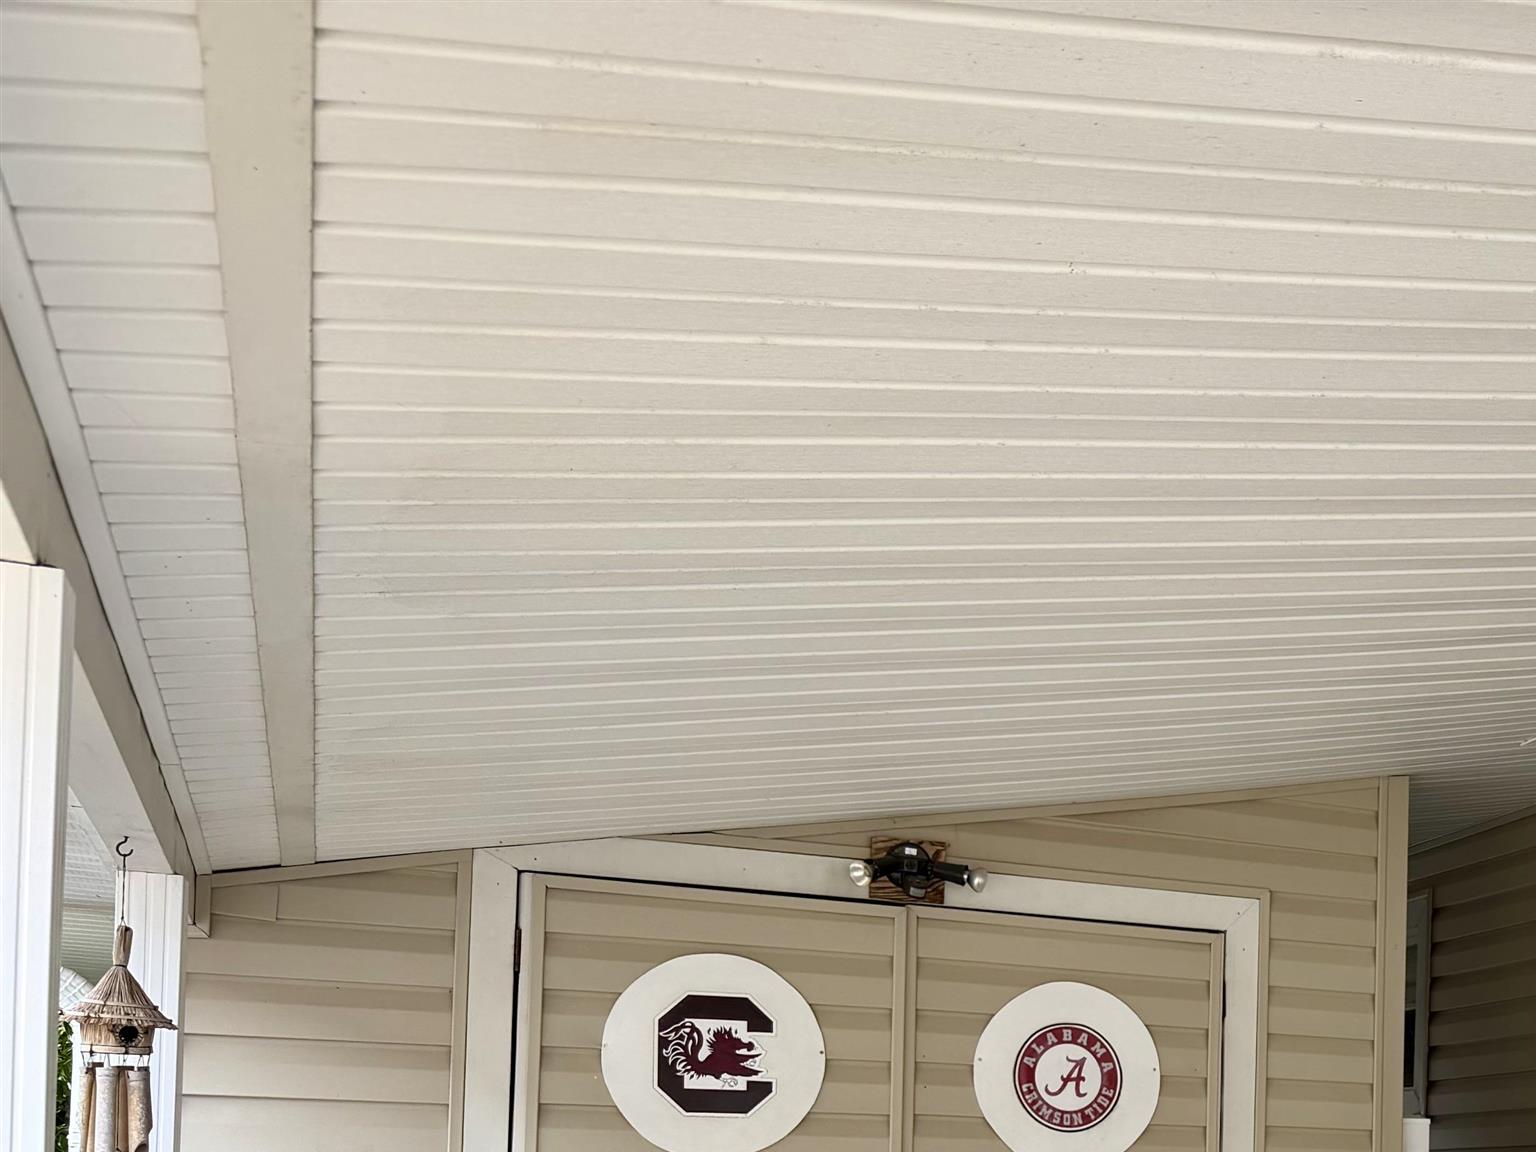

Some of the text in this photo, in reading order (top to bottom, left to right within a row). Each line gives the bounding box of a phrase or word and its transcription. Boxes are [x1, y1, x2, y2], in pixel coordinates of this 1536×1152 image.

[1023, 1028, 1114, 1073] ALABAMA
[1044, 1055, 1088, 1098] A
[1021, 1082, 1115, 1126] CRIMSON TIDE
